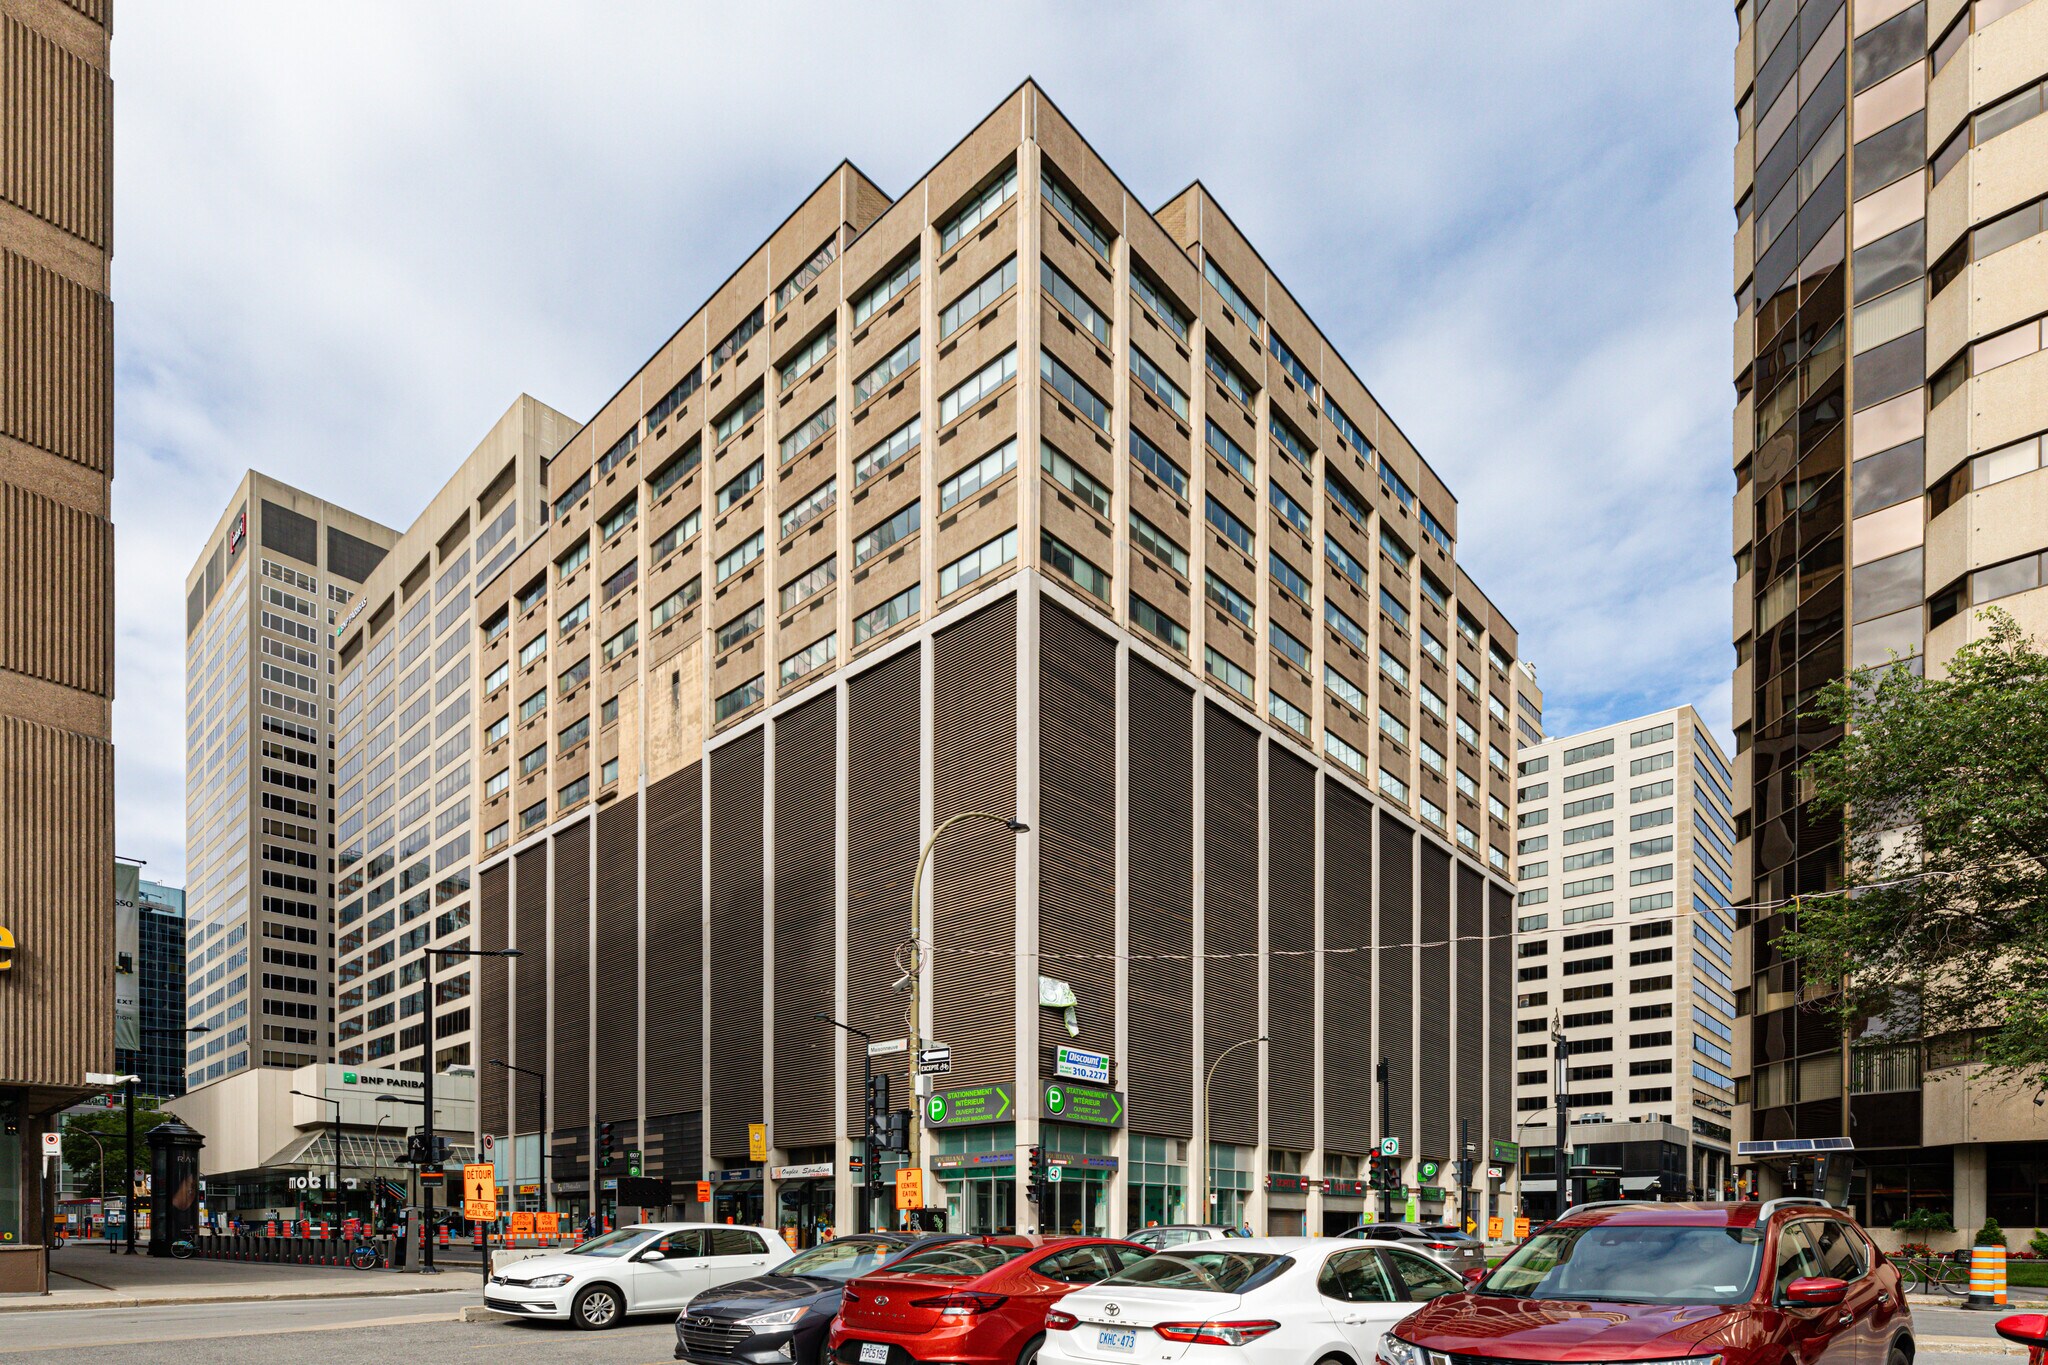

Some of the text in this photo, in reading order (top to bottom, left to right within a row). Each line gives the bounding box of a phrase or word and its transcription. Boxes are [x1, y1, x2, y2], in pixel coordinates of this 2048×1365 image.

[1068, 1052, 1100, 1066] Discount
[1072, 1067, 1107, 1080] 310.2277
[361, 1076, 424, 1089] BNP PARIBA
[947, 1088, 993, 1100] STATIONNEMENT
[1065, 1087, 1108, 1099] STATIONNEMENT
[955, 1098, 985, 1107] INTÉRIEUR
[1049, 1091, 1061, 1109] P
[1073, 1097, 1100, 1106] INTÉRIEUR
[931, 1100, 943, 1119] P
[289, 1171, 357, 1189] mobla
[466, 1168, 492, 1180] DÉTOUR
[906, 1172, 912, 1180] P
[1088, 1317, 1139, 1326] CAMRY
